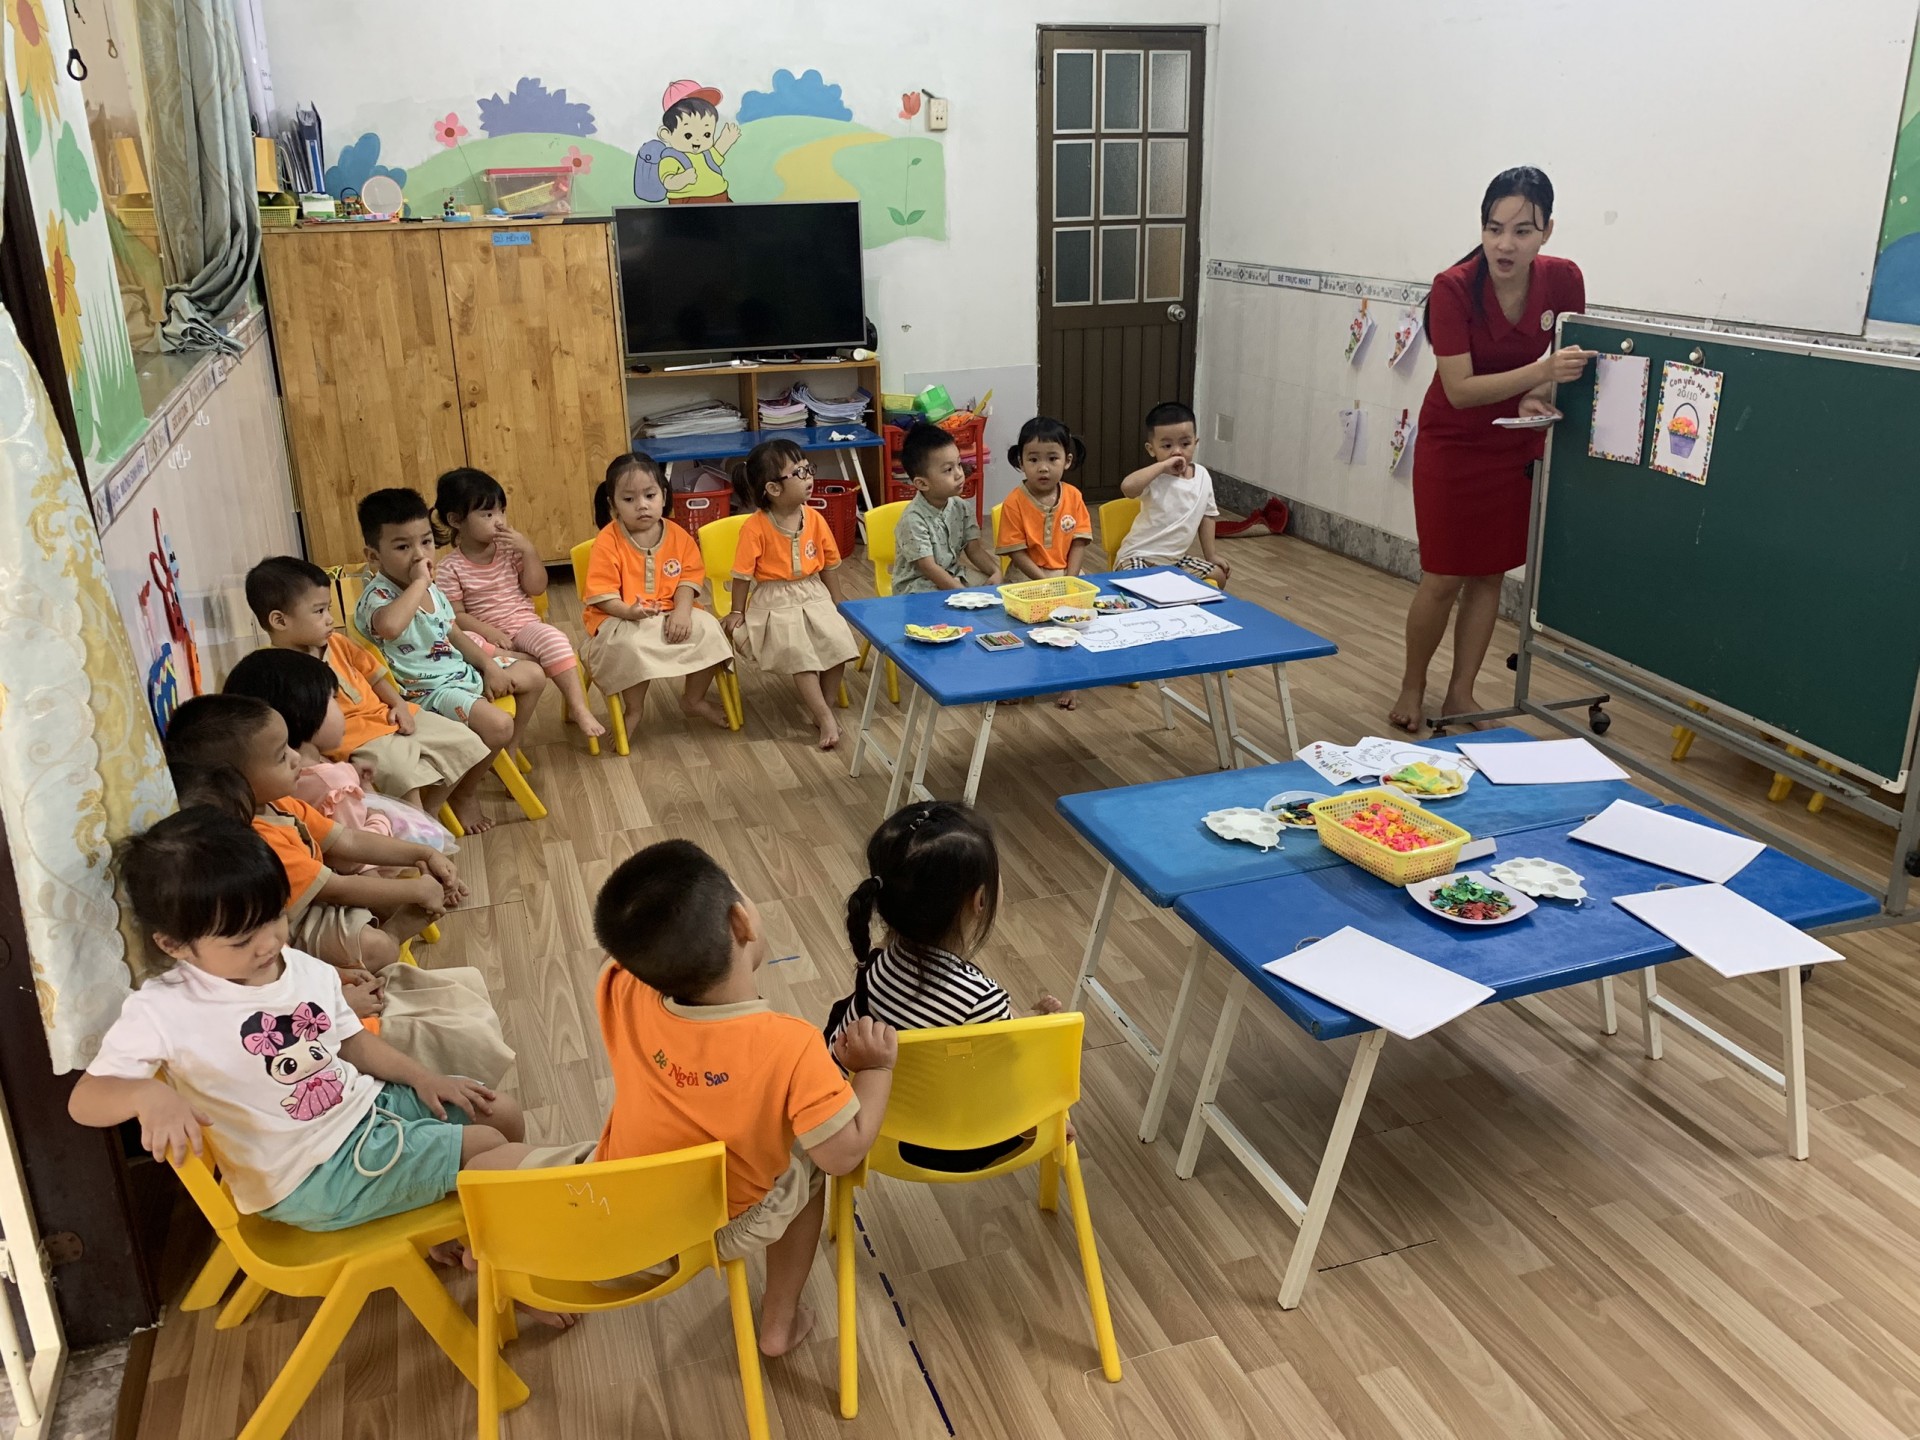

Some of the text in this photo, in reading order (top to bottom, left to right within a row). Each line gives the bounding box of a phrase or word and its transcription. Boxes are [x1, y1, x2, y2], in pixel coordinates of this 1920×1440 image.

[1669, 377, 1683, 388] Con
[1683, 376, 1696, 390] yêu
[1676, 388, 1698, 401] 20/10
[652, 1049, 729, 1088] Bé Ngôi Sao
